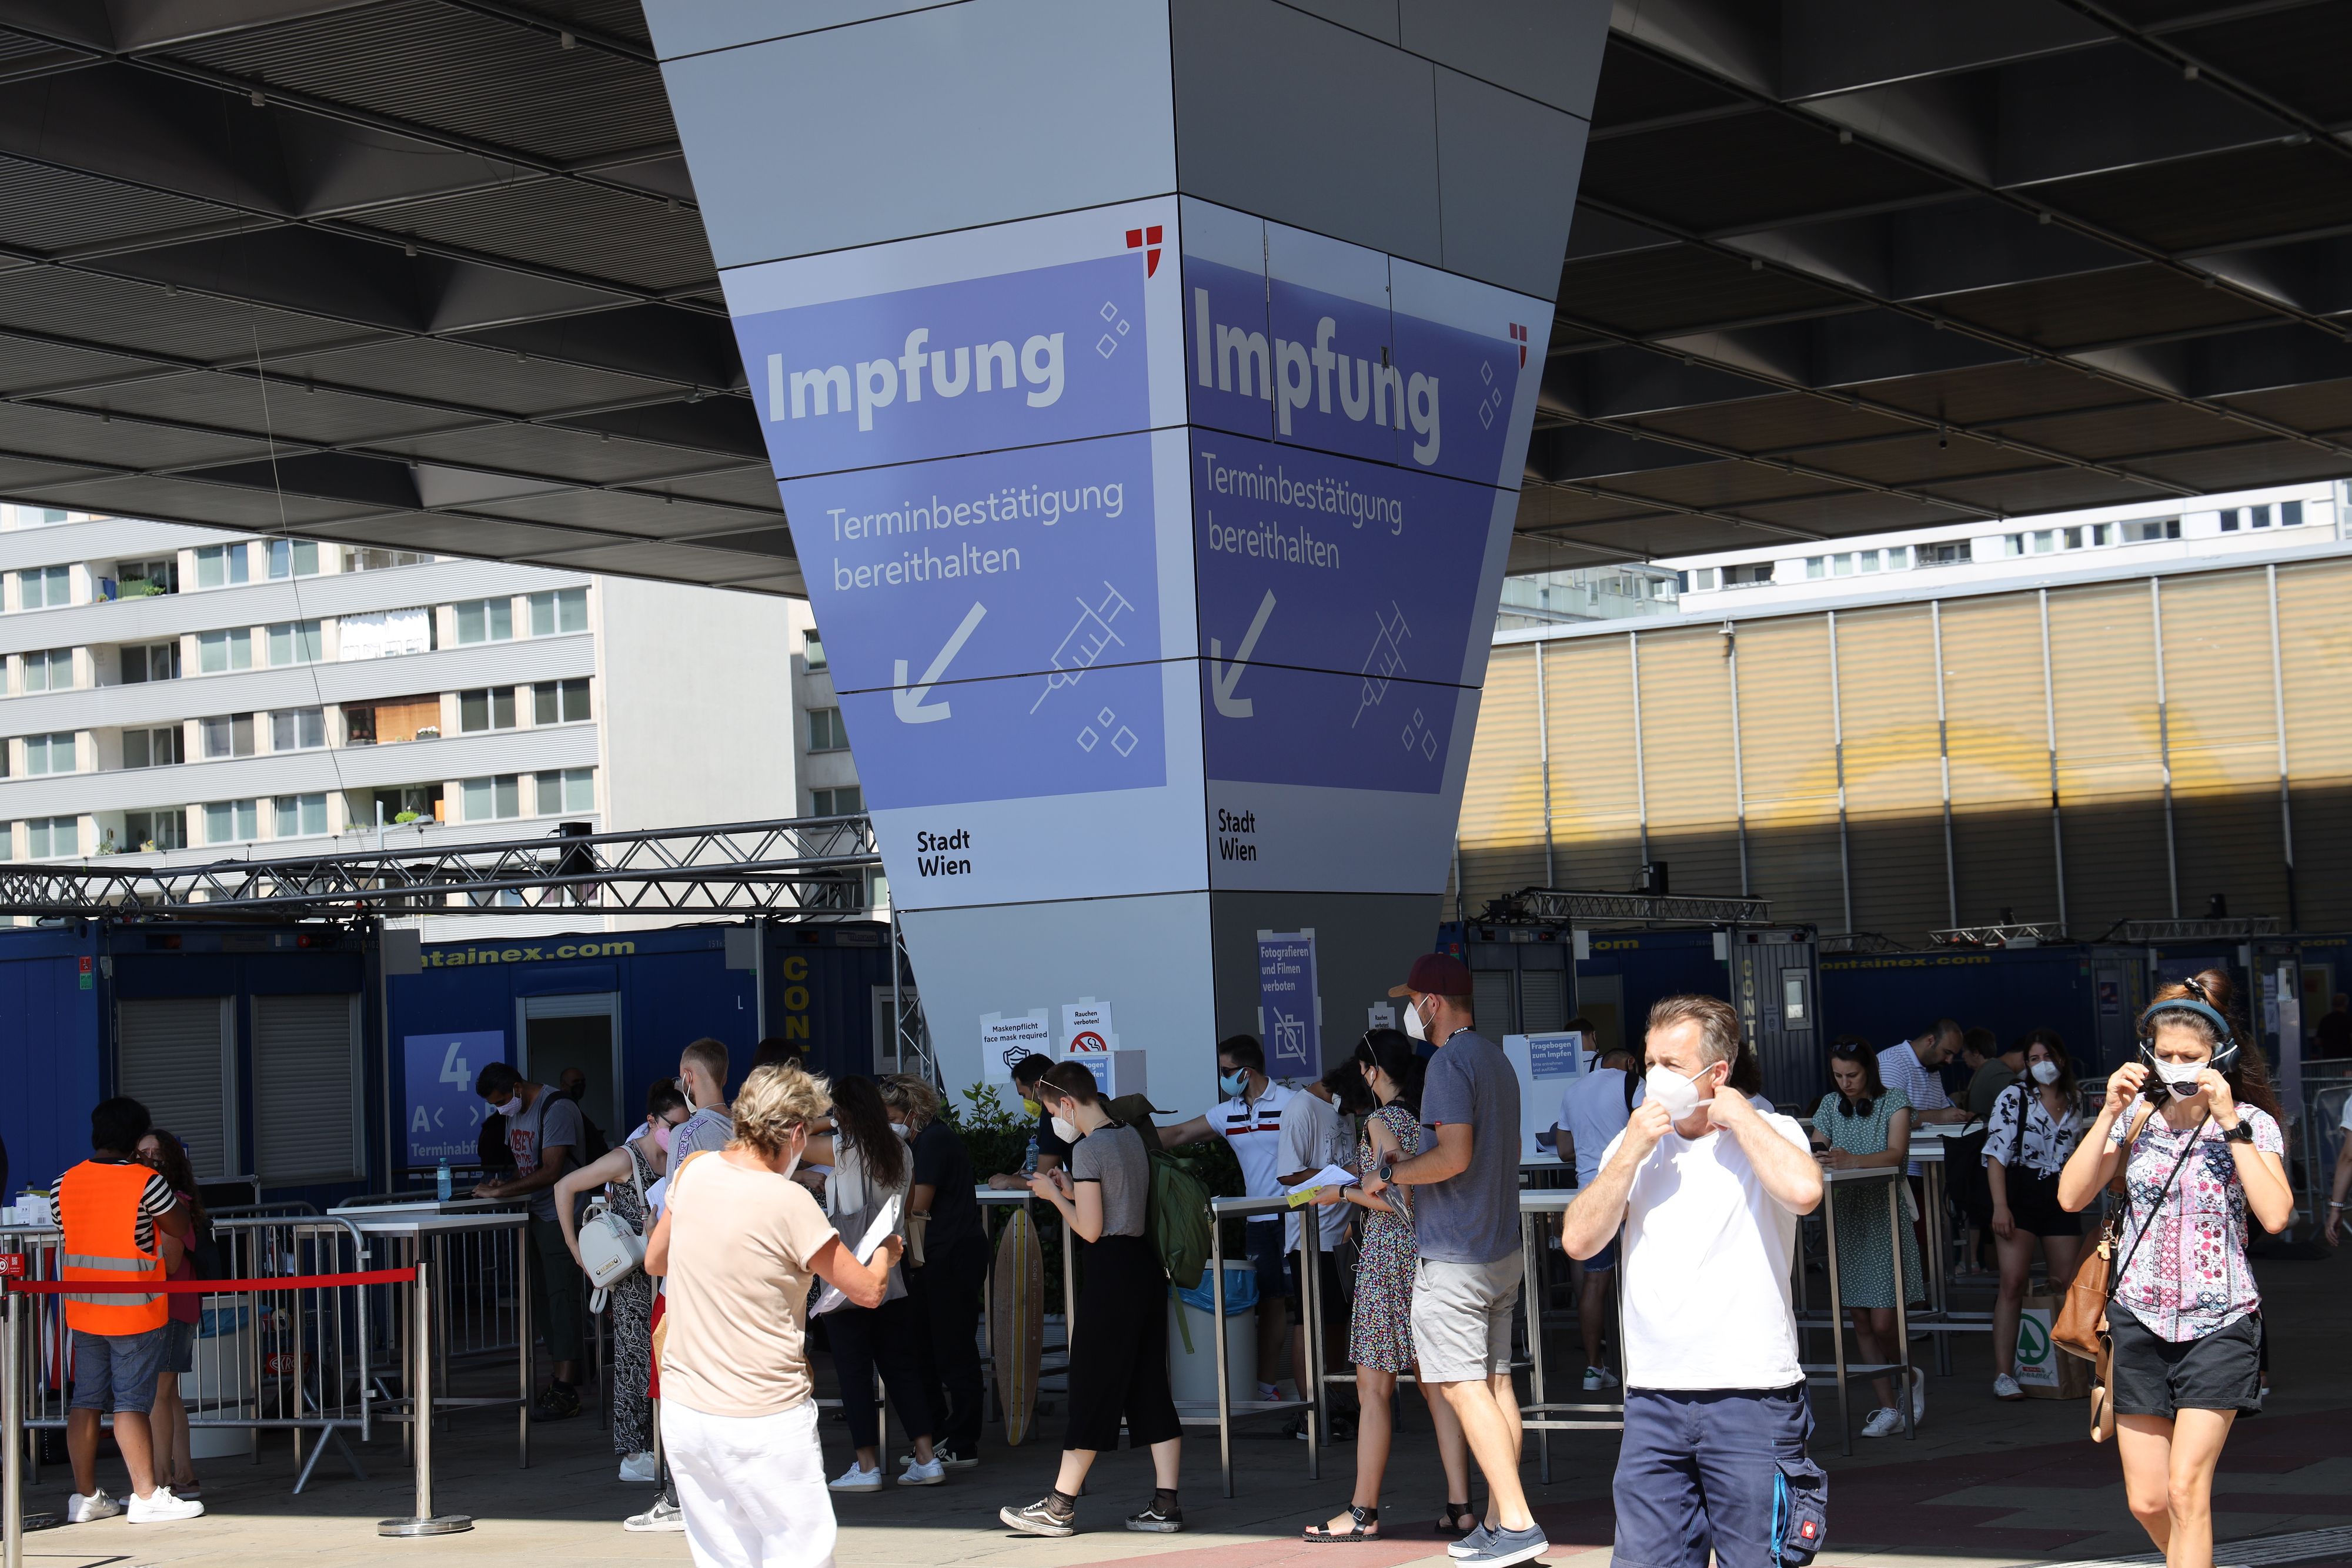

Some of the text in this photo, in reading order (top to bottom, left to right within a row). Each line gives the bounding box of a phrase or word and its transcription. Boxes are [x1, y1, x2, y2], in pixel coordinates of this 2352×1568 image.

[767, 328, 1065, 432] Impfung
[1195, 287, 1439, 465] Impfung
[1202, 452, 1402, 535] Terminbestätigung
[827, 483, 1124, 541] Terminbestätigung
[1208, 510, 1339, 569] bereithalten
[834, 542, 1020, 590] bereithalten
[1218, 808, 1255, 833] Stadt
[917, 829, 970, 852] Stadt
[1219, 837, 1256, 861] Wien
[918, 857, 970, 877] Wien
[1261, 945, 1308, 961] Fotografieren
[1262, 962, 1300, 975] und Filmen
[1263, 979, 1295, 992] verboten
[737, 995, 744, 1009] L
[784, 956, 810, 1052] CON
[993, 1023, 1038, 1032] Maskenpflicht
[1019, 1031, 1047, 1041] required
[1532, 1041, 1571, 1051] Fragebogen
[1548, 1050, 1572, 1059] Impfen
[439, 1042, 471, 1091] 4
[411, 1105, 430, 1133] A
[272, 1356, 294, 1371] EKR
